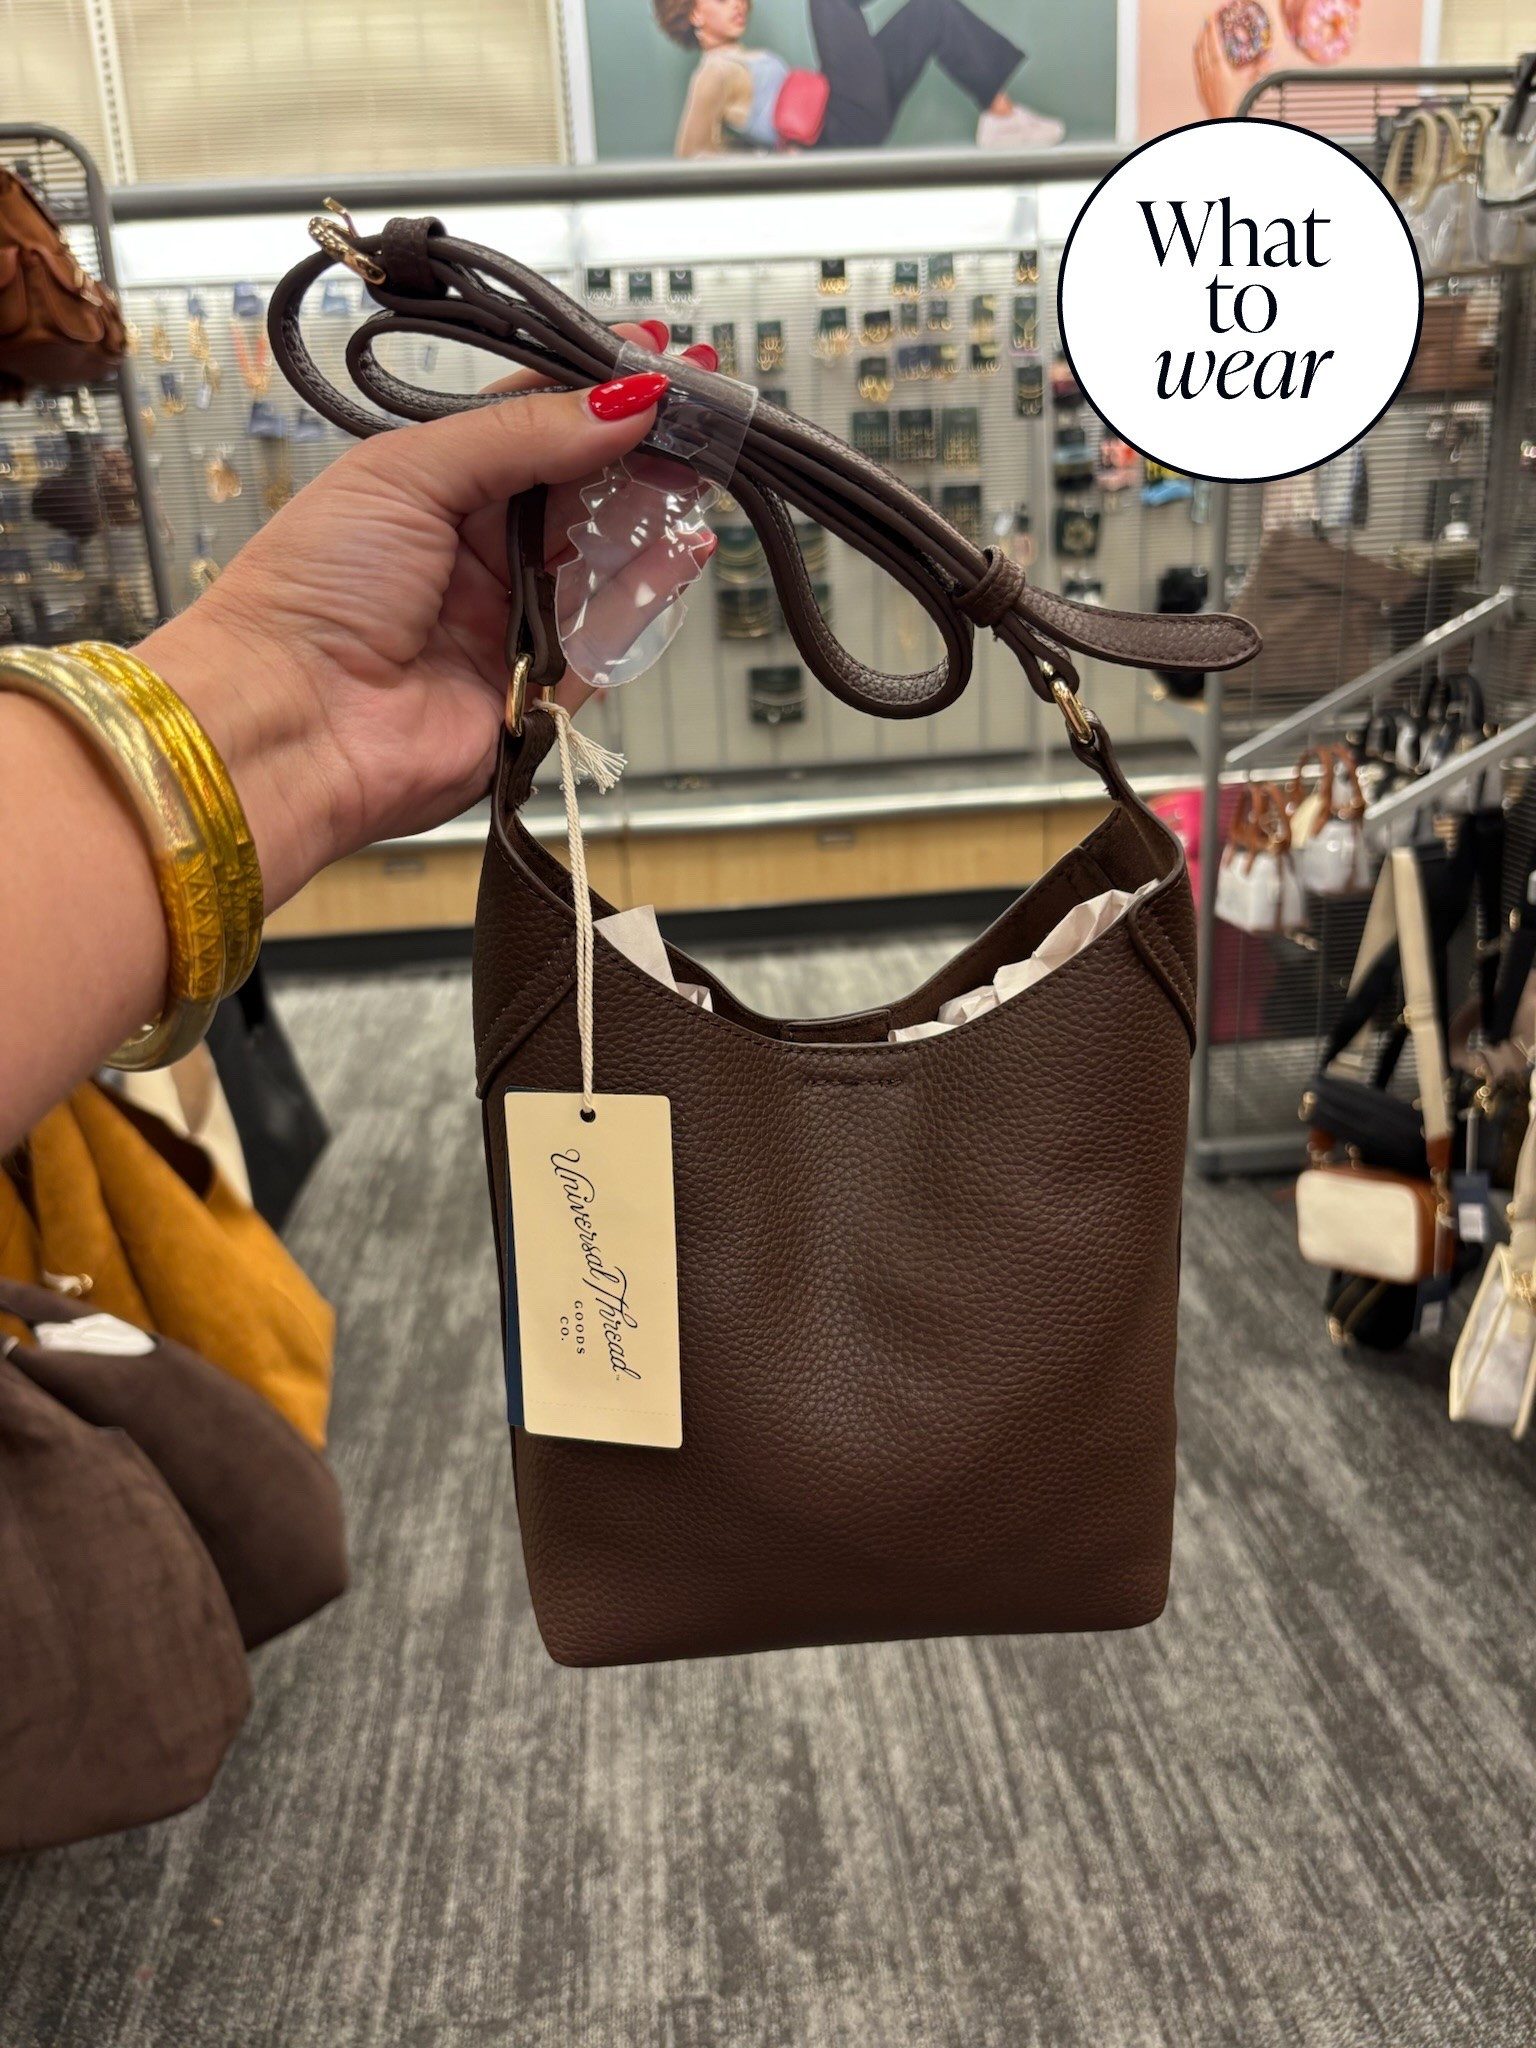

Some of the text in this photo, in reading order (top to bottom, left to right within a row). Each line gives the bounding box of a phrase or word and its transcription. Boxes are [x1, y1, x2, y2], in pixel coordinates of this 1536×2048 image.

[550, 1148, 641, 1380] Universal Thread
[560, 1316, 570, 1342] CO.
[574, 1300, 585, 1355] GOODS
